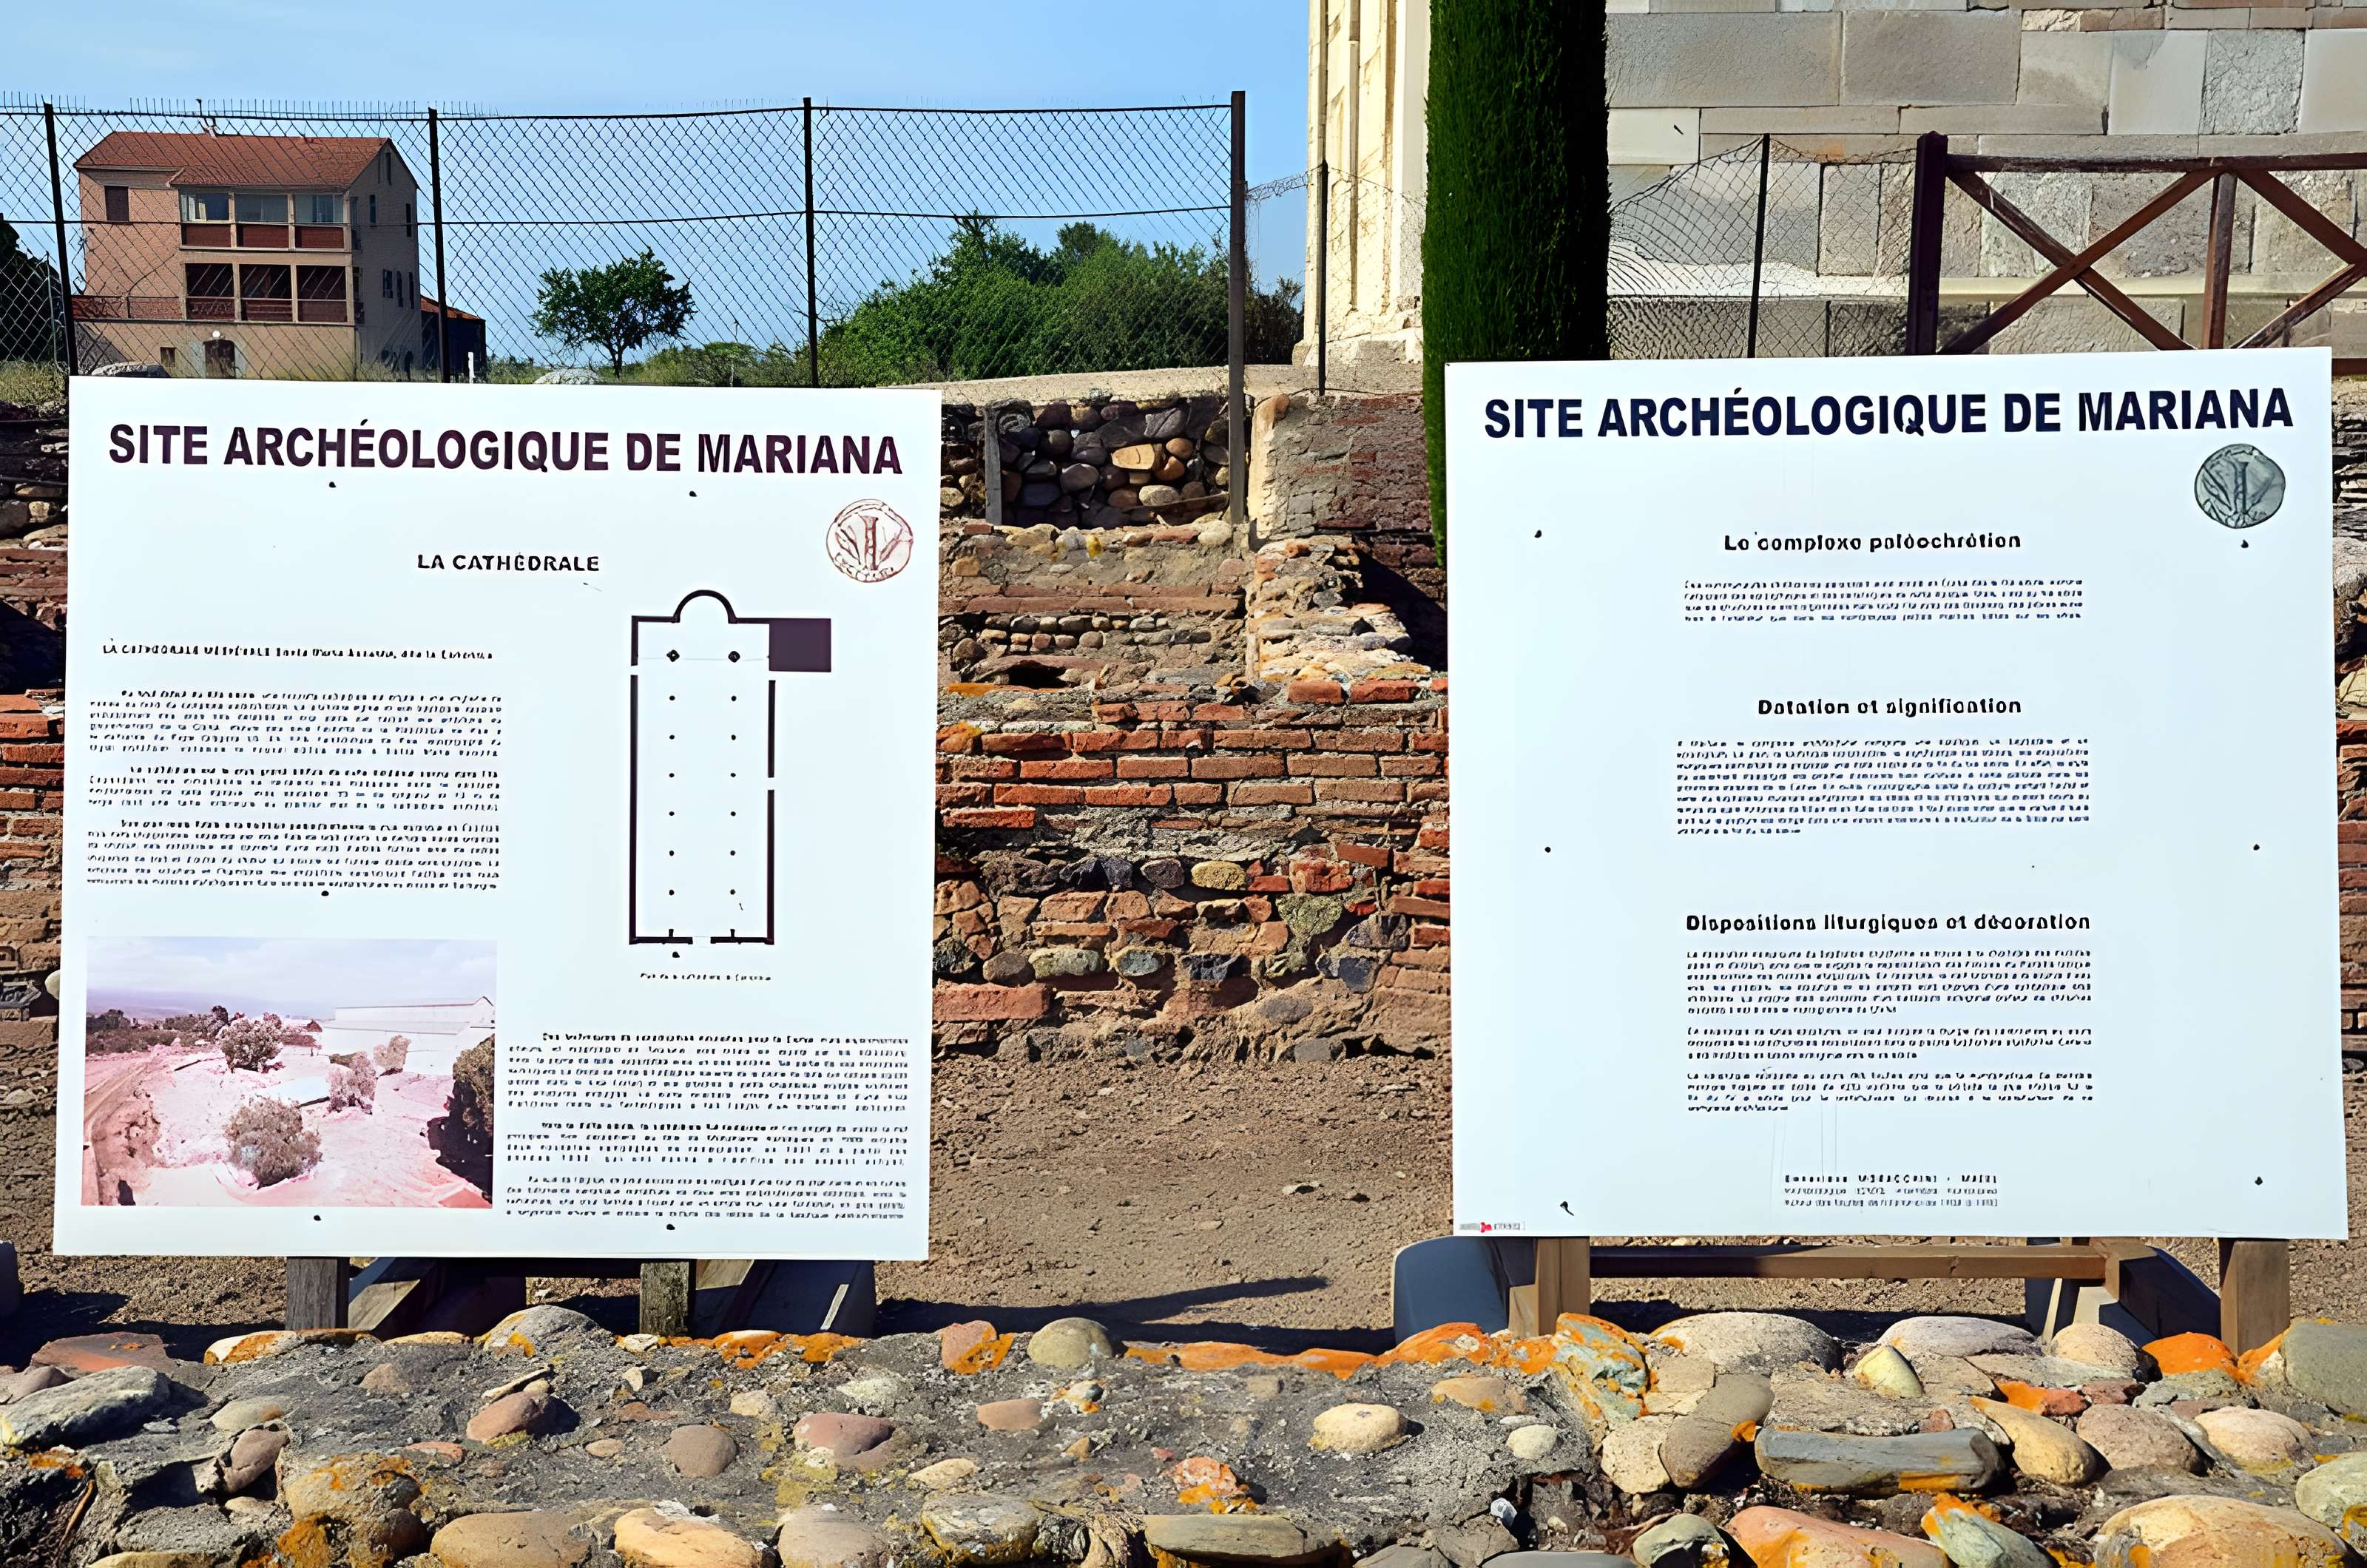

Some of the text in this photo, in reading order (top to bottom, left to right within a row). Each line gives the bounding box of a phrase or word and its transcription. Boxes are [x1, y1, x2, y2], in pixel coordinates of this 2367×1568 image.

[1485, 387, 2295, 439] SITE ARCHÉOLOGIQUE DE MARIANA
[109, 419, 903, 475] SITE ARCHÉOLOGIQUE DE MARIANA
[417, 553, 600, 572] LA CATHÉDRALE
